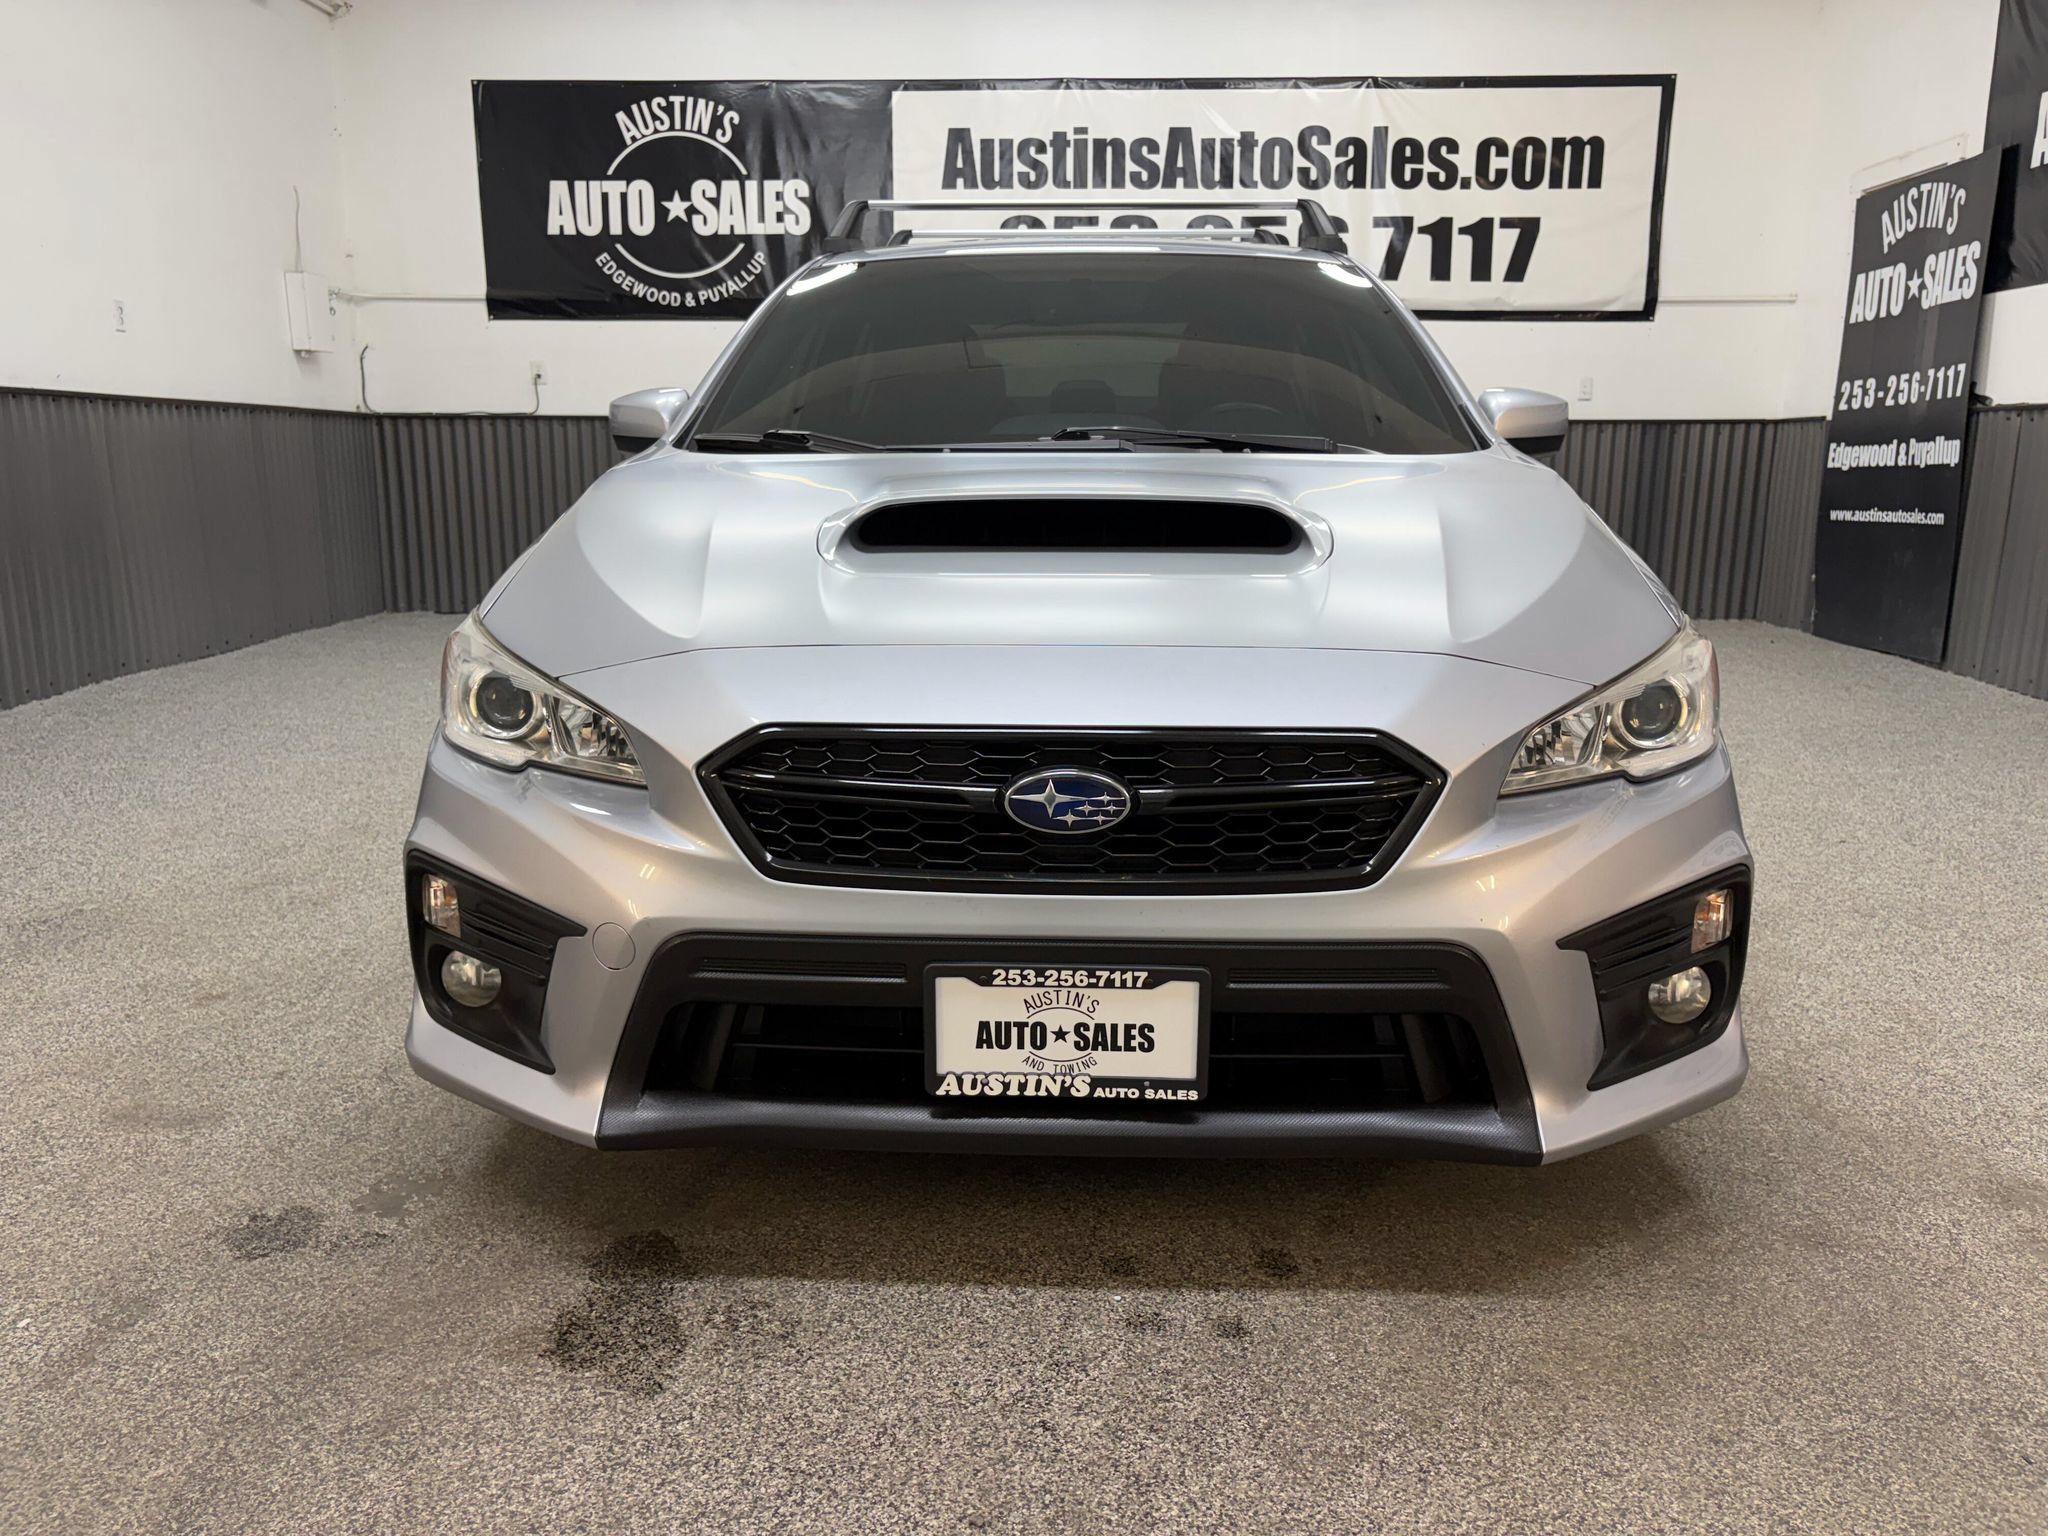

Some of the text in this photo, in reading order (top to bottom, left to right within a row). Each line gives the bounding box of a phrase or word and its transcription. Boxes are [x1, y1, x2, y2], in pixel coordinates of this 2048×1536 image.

[614, 95, 740, 146] AUSTIN'S
[942, 126, 1605, 190] AustinsAutoSales.com
[547, 178, 812, 236] AUTO SALES
[1881, 182, 1966, 254] AUSTIN'S
[594, 251, 768, 307] EDGEWOOD & PUYALLUP
[1849, 240, 1981, 324] AUTO SALES
[1838, 363, 1967, 411] 253-256-7117
[1827, 436, 1961, 471] Edgewood & Puyallup
[1830, 507, 1945, 526] www.austinsautosales.com
[992, 969, 1149, 989] 253-256-7117
[1023, 990, 1100, 1014] AUSTIN'S
[975, 1021, 1155, 1053] AUTO SALES
[1022, 1055, 1098, 1075] AND TOWING
[936, 1073, 1199, 1101] AUSTIN'S AUTO SALES
